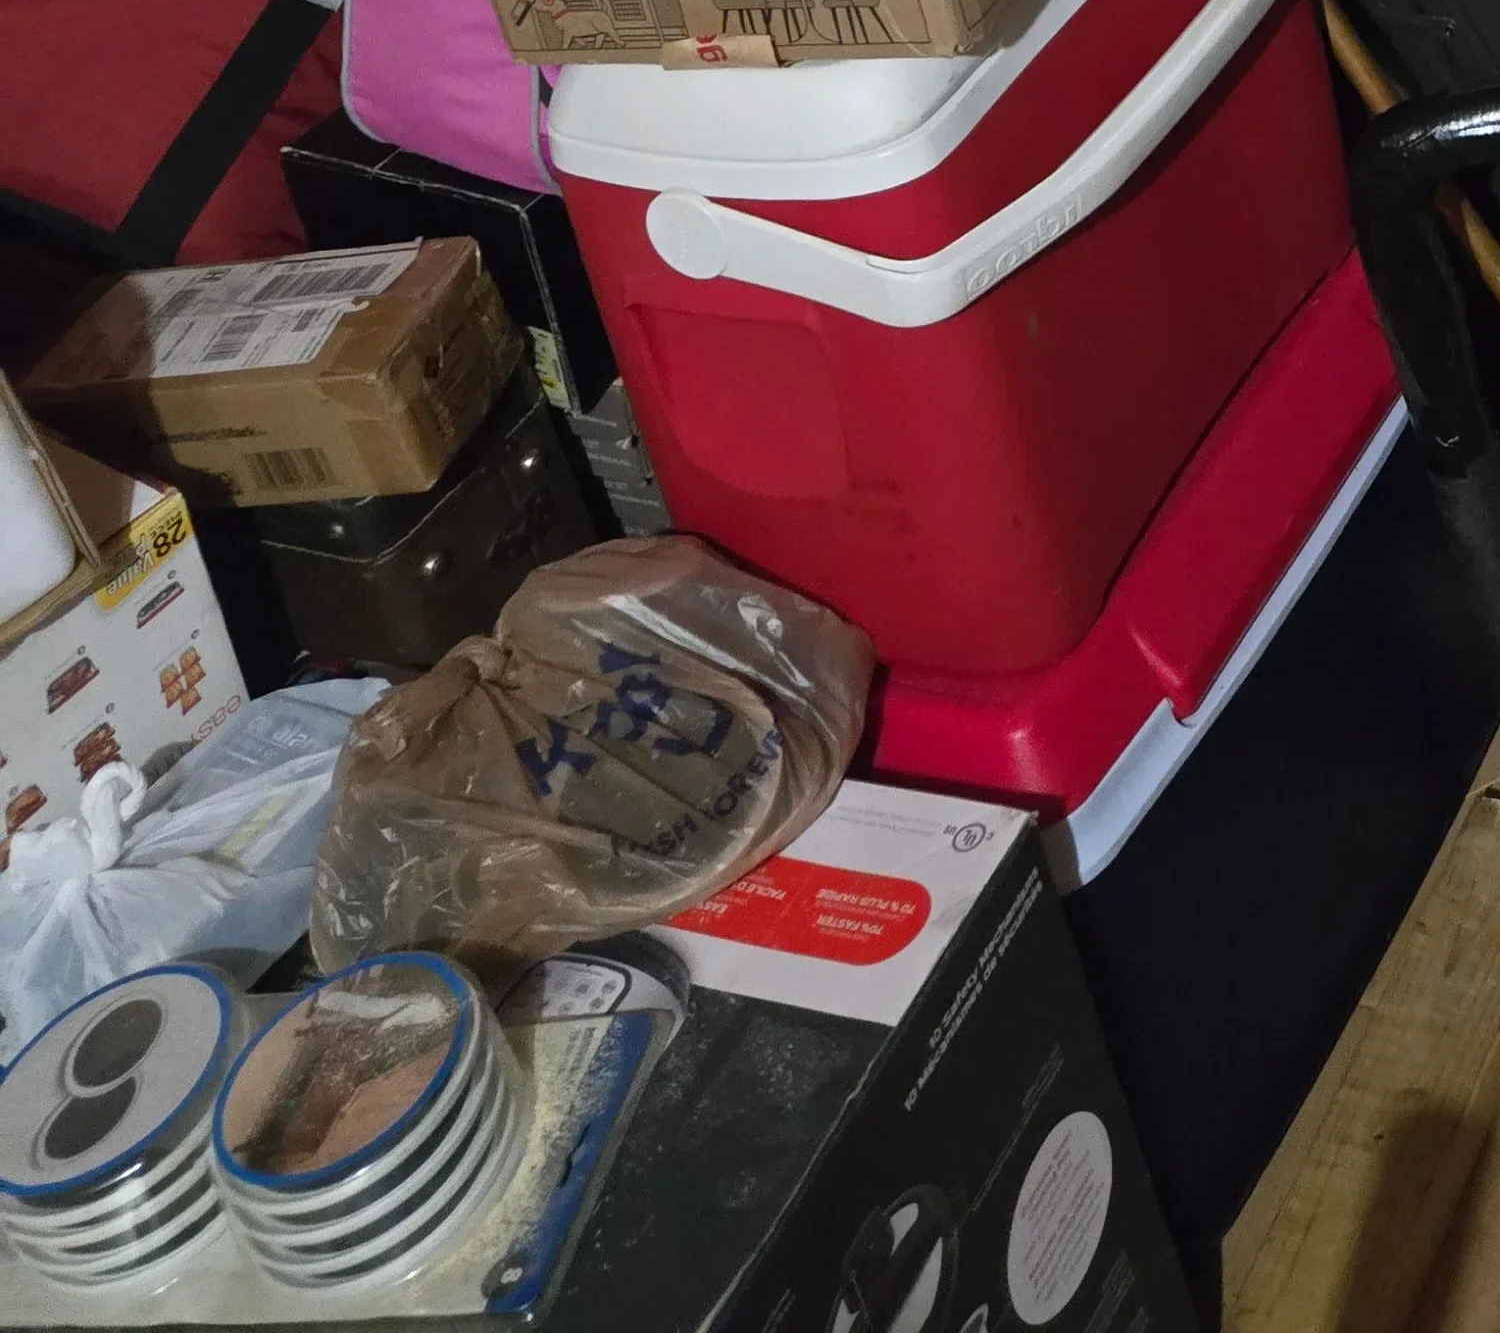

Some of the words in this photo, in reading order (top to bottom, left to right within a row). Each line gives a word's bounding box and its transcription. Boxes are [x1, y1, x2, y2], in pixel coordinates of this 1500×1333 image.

[150, 518, 188, 560] 28
[106, 549, 155, 594] Value
[816, 915, 860, 930] FASTER
